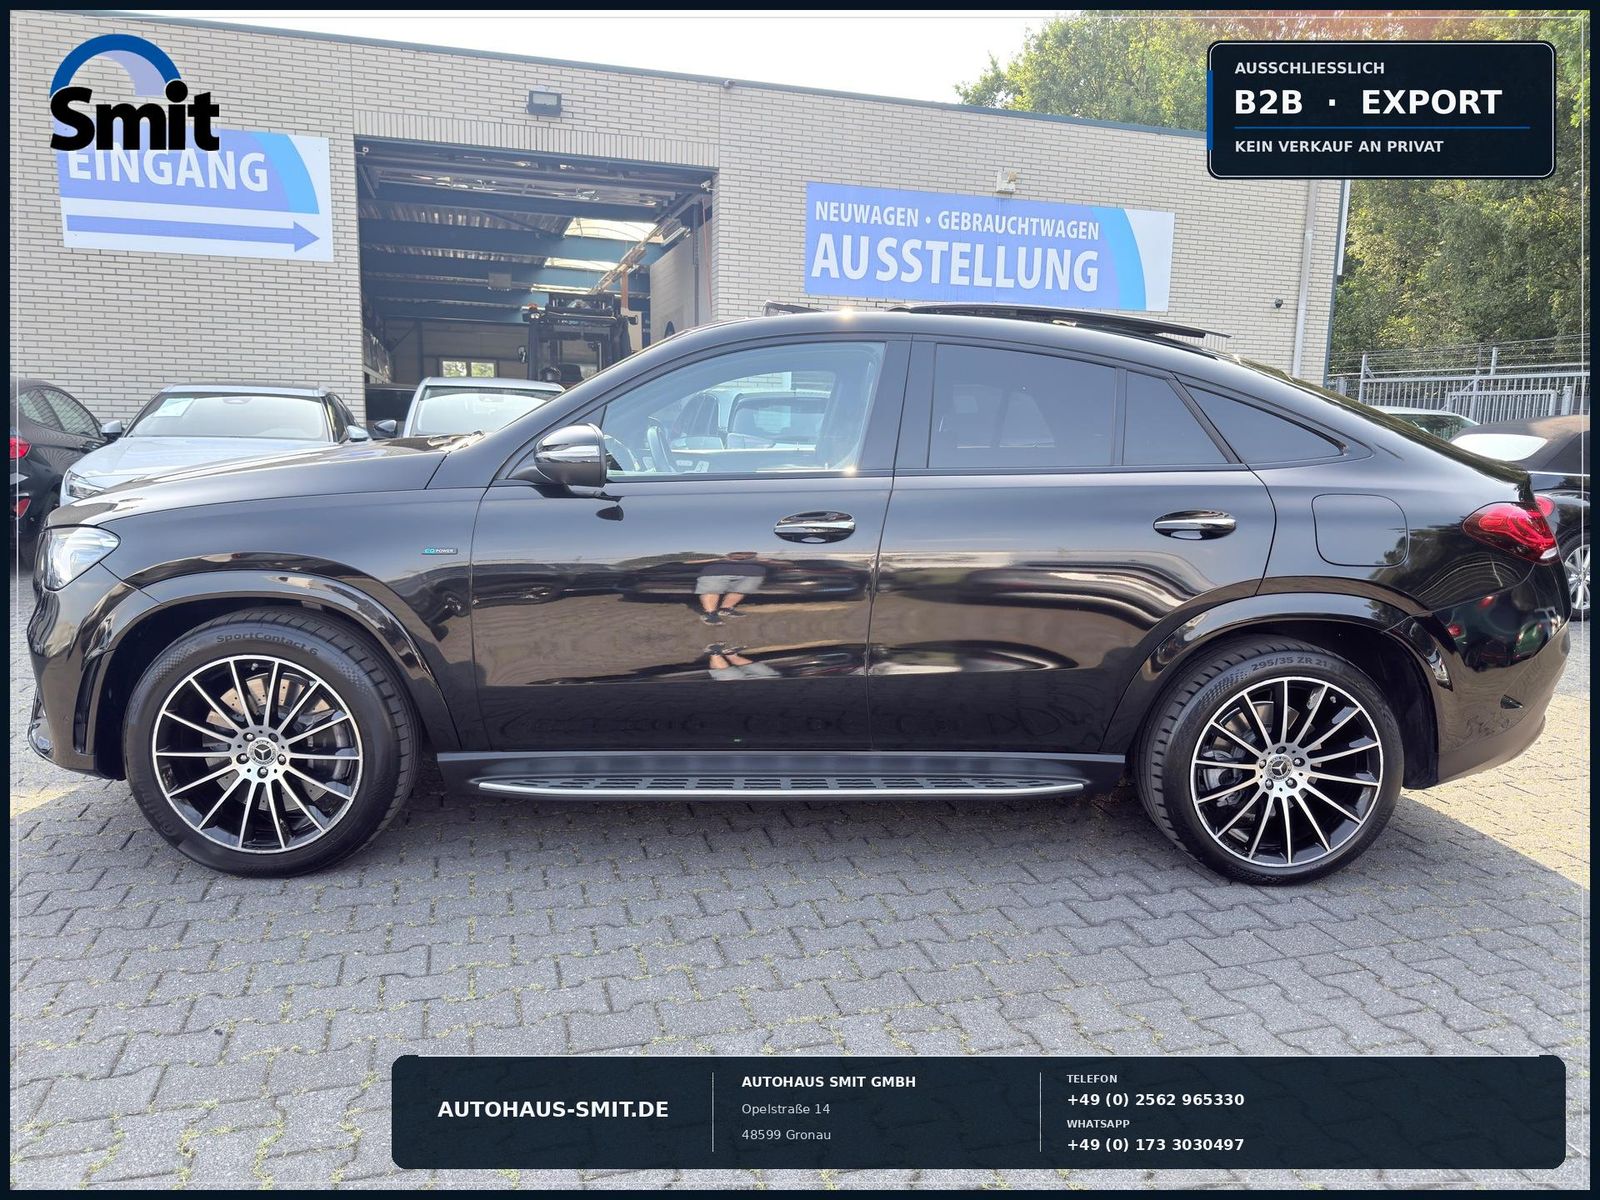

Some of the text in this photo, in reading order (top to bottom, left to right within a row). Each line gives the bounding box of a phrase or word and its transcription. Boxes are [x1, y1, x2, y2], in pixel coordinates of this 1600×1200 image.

[67, 142, 269, 192] EINGANG
[815, 201, 919, 227] NEUWAGEN
[938, 210, 1100, 240] GEBRAUCHTWAGEN
[810, 233, 1099, 292] AUSSTELLUNG
[217, 632, 319, 656] SportContact 6
[1252, 657, 1294, 671] 295/35
[1315, 658, 1328, 668] 21
